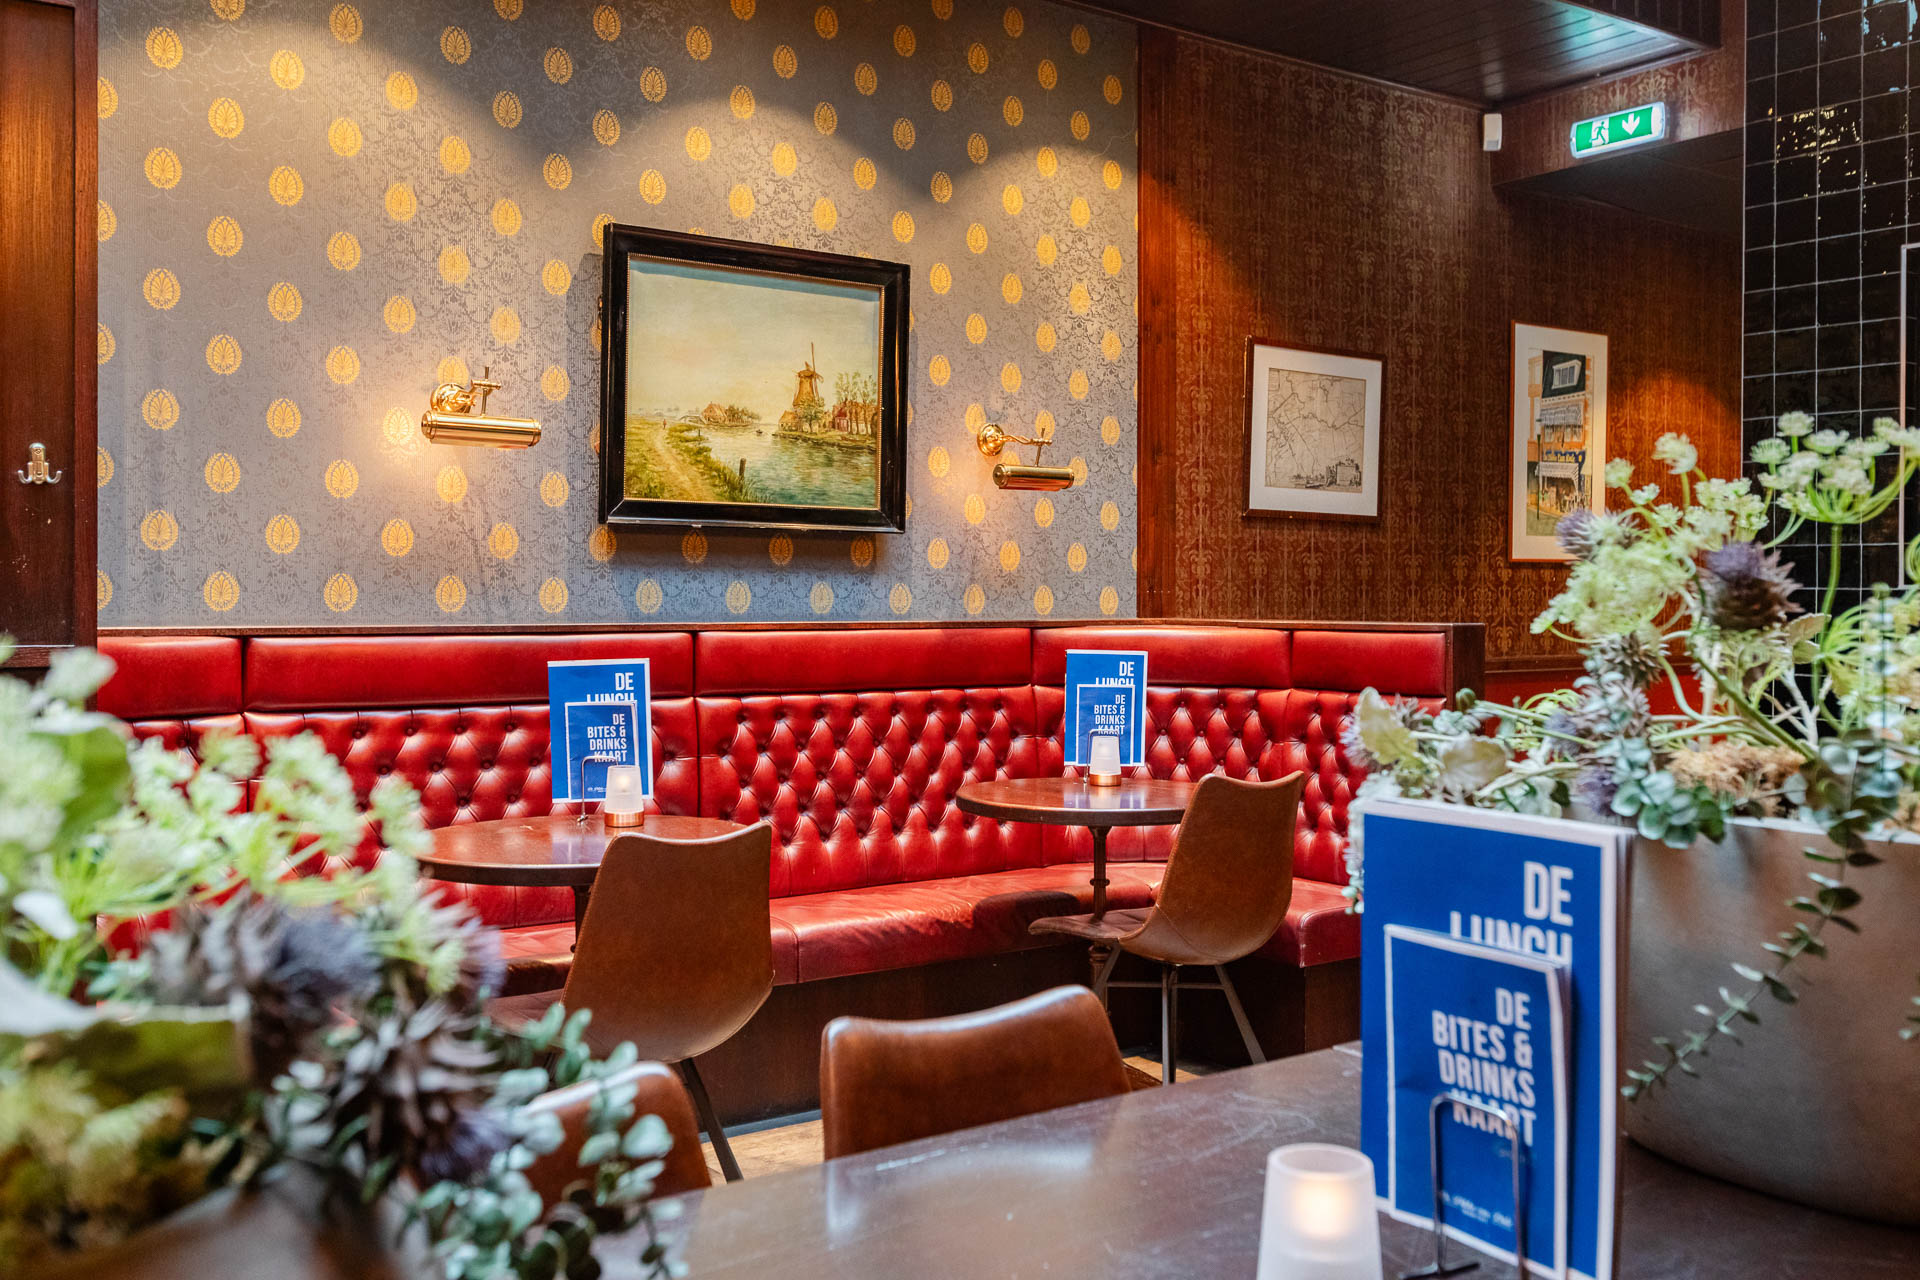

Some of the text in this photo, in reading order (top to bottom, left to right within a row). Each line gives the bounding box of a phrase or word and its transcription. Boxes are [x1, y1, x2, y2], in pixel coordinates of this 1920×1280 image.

[1119, 661, 1135, 677] DE
[615, 672, 634, 691] DE
[1115, 694, 1126, 705] DE
[1094, 704, 1126, 714] BITES &
[612, 713, 626, 725] DE
[1095, 714, 1126, 725] DRINKS
[587, 726, 626, 738] BITES &
[589, 738, 627, 751] DRINKS
[1523, 861, 1574, 926] DE
[1495, 987, 1532, 1031] DE
[1432, 1009, 1534, 1069] BITES &
[1438, 1048, 1537, 1109] DRINKS
